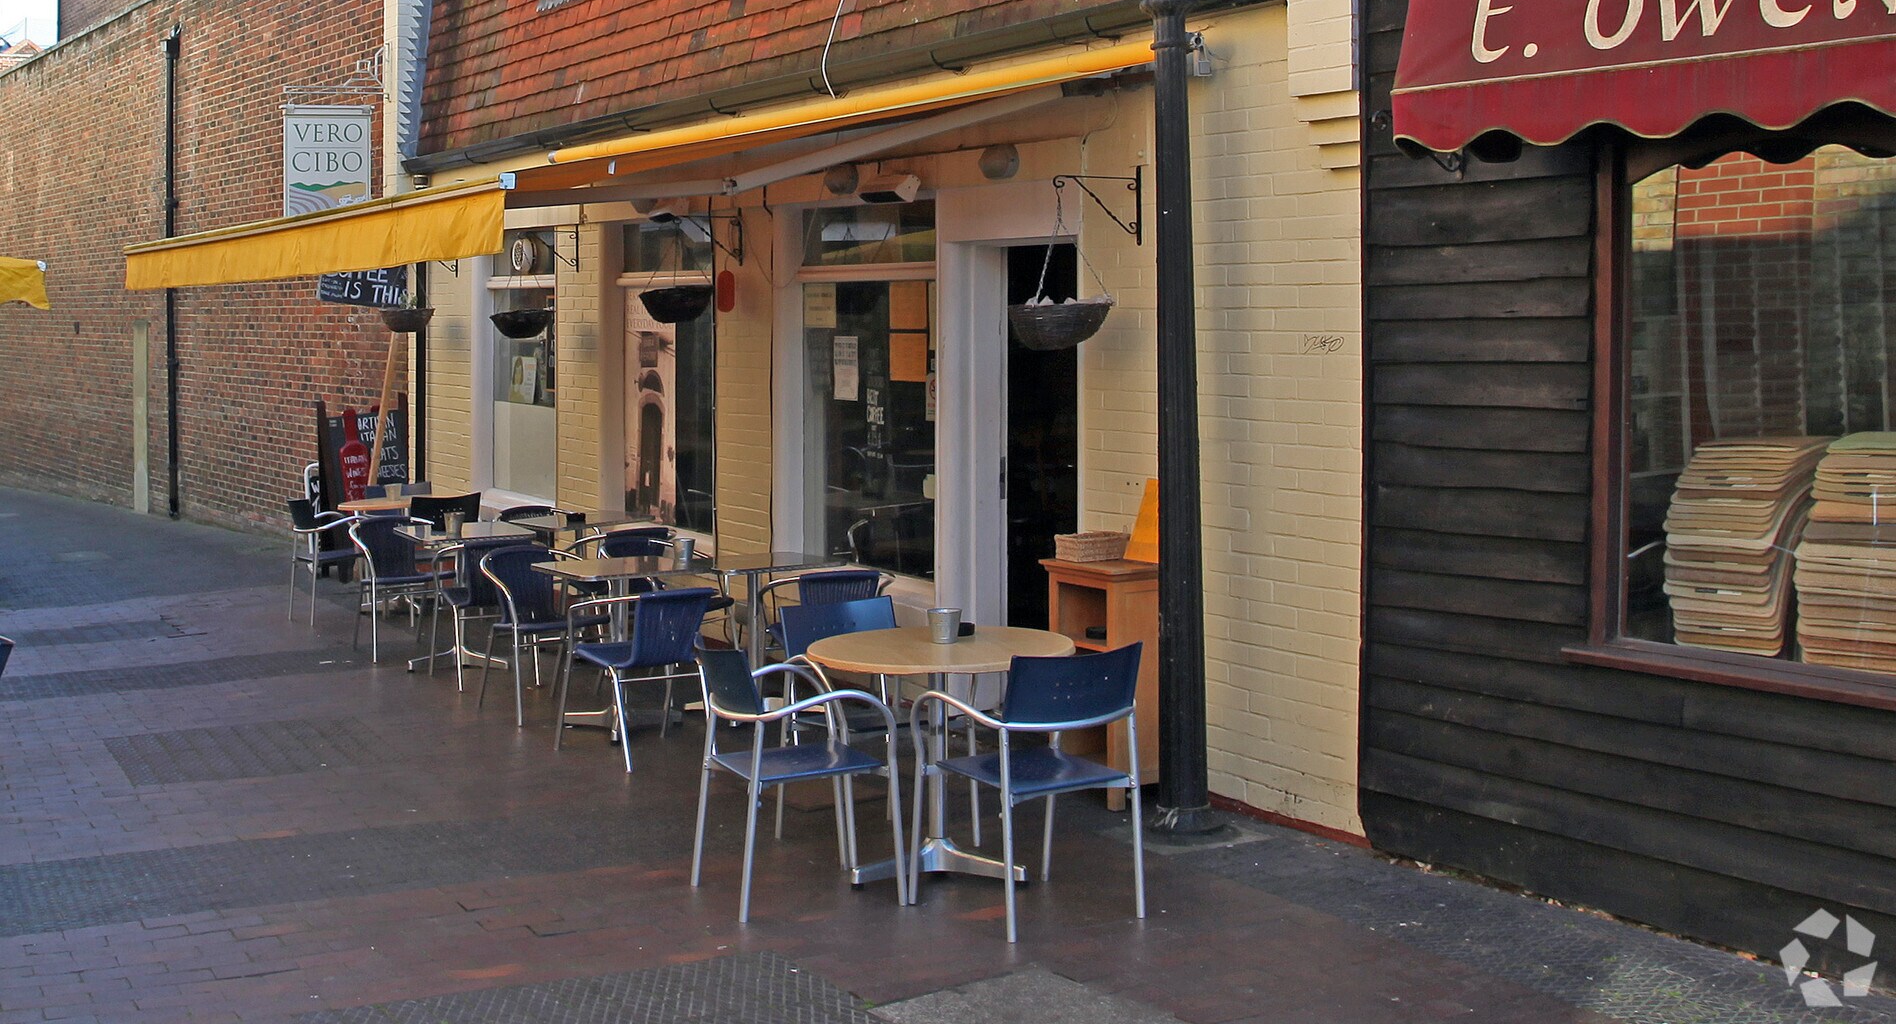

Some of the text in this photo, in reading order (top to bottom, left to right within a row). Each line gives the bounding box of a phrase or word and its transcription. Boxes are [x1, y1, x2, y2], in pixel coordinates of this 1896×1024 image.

[293, 123, 363, 143] VERO
[292, 151, 363, 173] CIBO
[344, 280, 362, 299] IS
[357, 412, 395, 430] ARTIN
[360, 428, 397, 443] ITAAN
